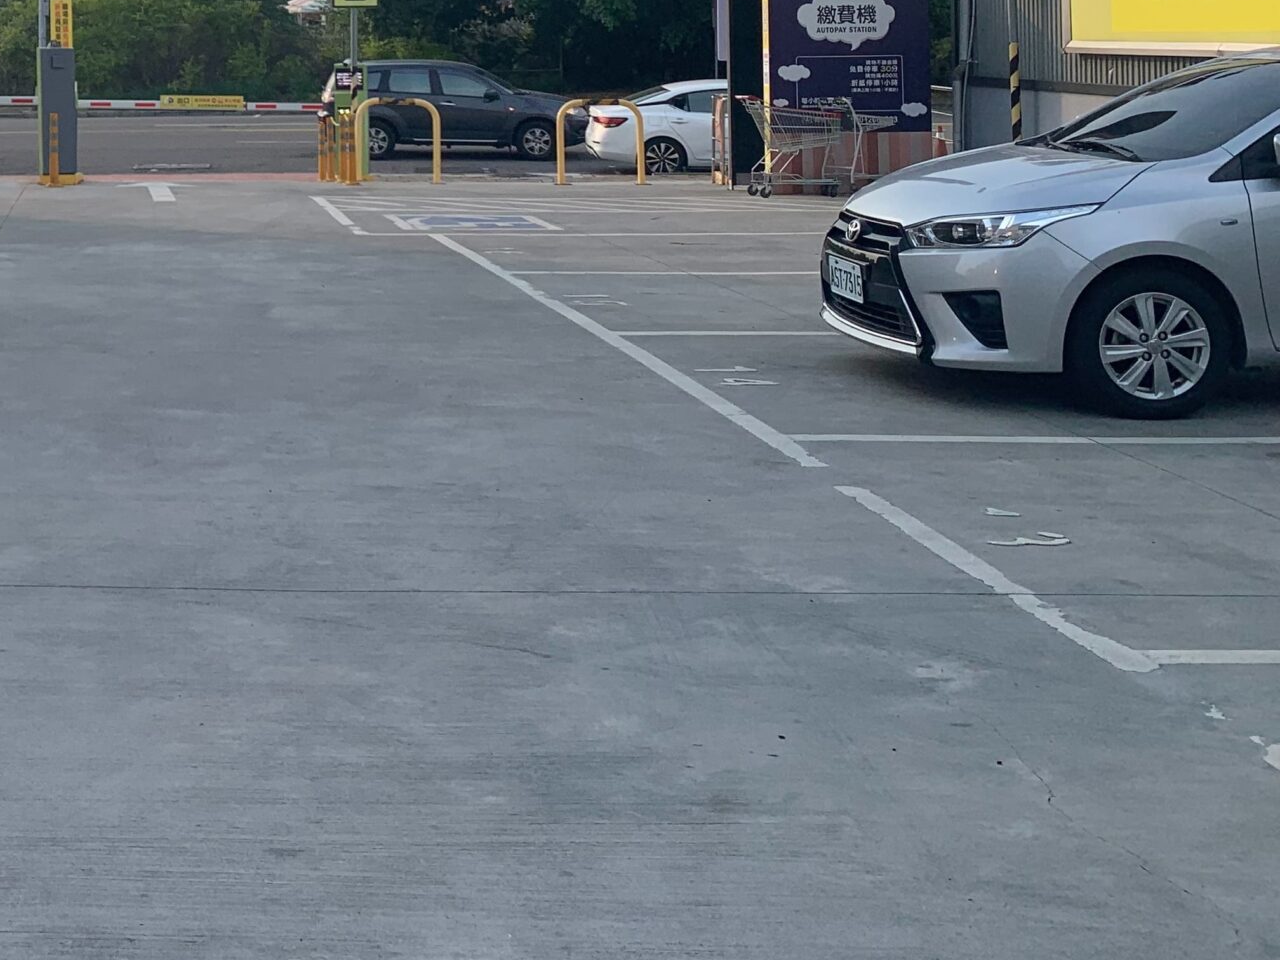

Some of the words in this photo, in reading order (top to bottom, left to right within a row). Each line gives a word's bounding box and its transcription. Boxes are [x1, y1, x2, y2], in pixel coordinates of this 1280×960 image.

[816, 4, 877, 25] 繳費機
[816, 26, 847, 34] AUTOPAY
